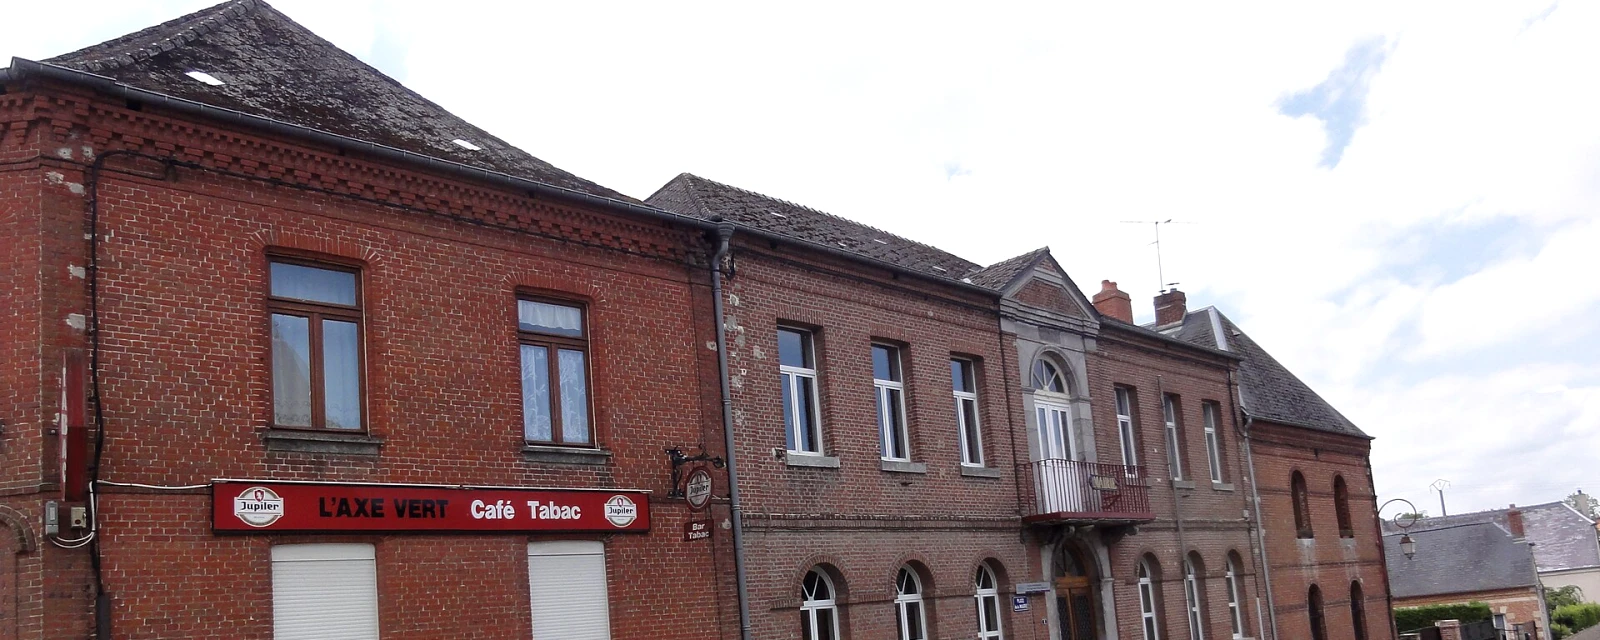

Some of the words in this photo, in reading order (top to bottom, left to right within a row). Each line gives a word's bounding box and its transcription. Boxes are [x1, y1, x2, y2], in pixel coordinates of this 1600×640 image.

[240, 501, 279, 512] Jupiler
[319, 498, 384, 518] L'AXE
[394, 499, 448, 519] VERT
[471, 499, 515, 520] Café
[527, 501, 581, 520] Tabac
[608, 506, 634, 515] Jupiler
[692, 523, 705, 531] Bar
[688, 531, 709, 540] Tabac
